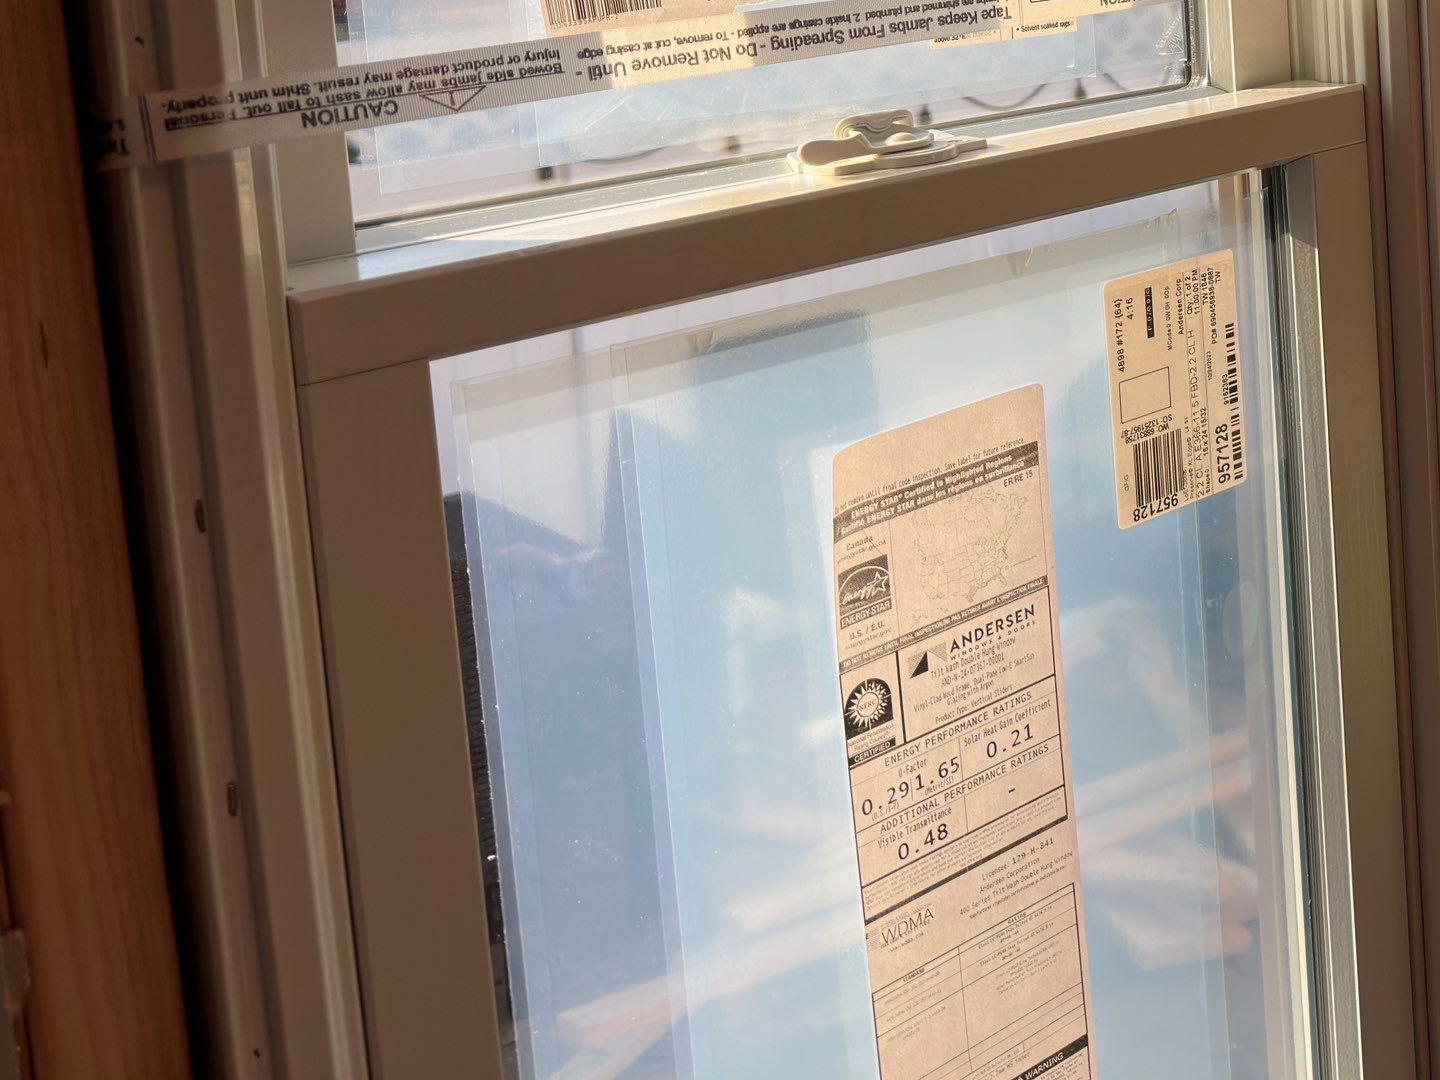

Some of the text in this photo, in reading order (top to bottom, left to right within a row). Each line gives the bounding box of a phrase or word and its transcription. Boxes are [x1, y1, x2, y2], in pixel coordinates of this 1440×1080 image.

[1020, 23, 1039, 32] Solvent
[577, 25, 769, 60] applied To remove, cut casing edge
[588, 6, 1013, 82] Tape Keeps Jambs From Spreading Do Not Remove Until
[239, 49, 560, 104] Injury or product damage may result. Shim unit
[276, 62, 562, 112] Bowed jambs may allow sash to fall
[301, 100, 399, 128] CAUTION
[1185, 283, 1192, 291] of
[1191, 269, 1199, 281] PM
[1214, 271, 1221, 284] TW
[1202, 292, 1209, 306] TW
[1187, 329, 1196, 355] CL H
[1117, 348, 1125, 373] 4898
[945, 462, 956, 470] Save
[1215, 423, 1231, 484] 957128
[1025, 469, 1033, 479] 15
[850, 502, 879, 520] ENERGY
[904, 482, 935, 499] Certified
[866, 500, 915, 524] ENERGY STAR
[1133, 493, 1179, 522] 957128
[841, 601, 891, 628] ENERGY STAR
[950, 604, 1035, 653] ANDERSEN
[950, 639, 993, 661] WINDOWS
[884, 692, 1032, 767] ENERGY PERFORMANCE RATINGS
[964, 700, 1052, 747] Solar Heat Gain Coefficient
[986, 723, 1033, 758] 0.21
[898, 758, 927, 778] U-Factor
[861, 756, 960, 816] 0.29 1.65
[880, 743, 1049, 834] ADDITIONAL PERFORMANCE RATINGS
[877, 807, 952, 849] Visible Transmittance
[898, 823, 949, 860] 0.48
[1012, 837, 1054, 866] 129-H-841
[881, 908, 935, 944] WDMA
[1025, 1051, 1064, 1080] WARNING
